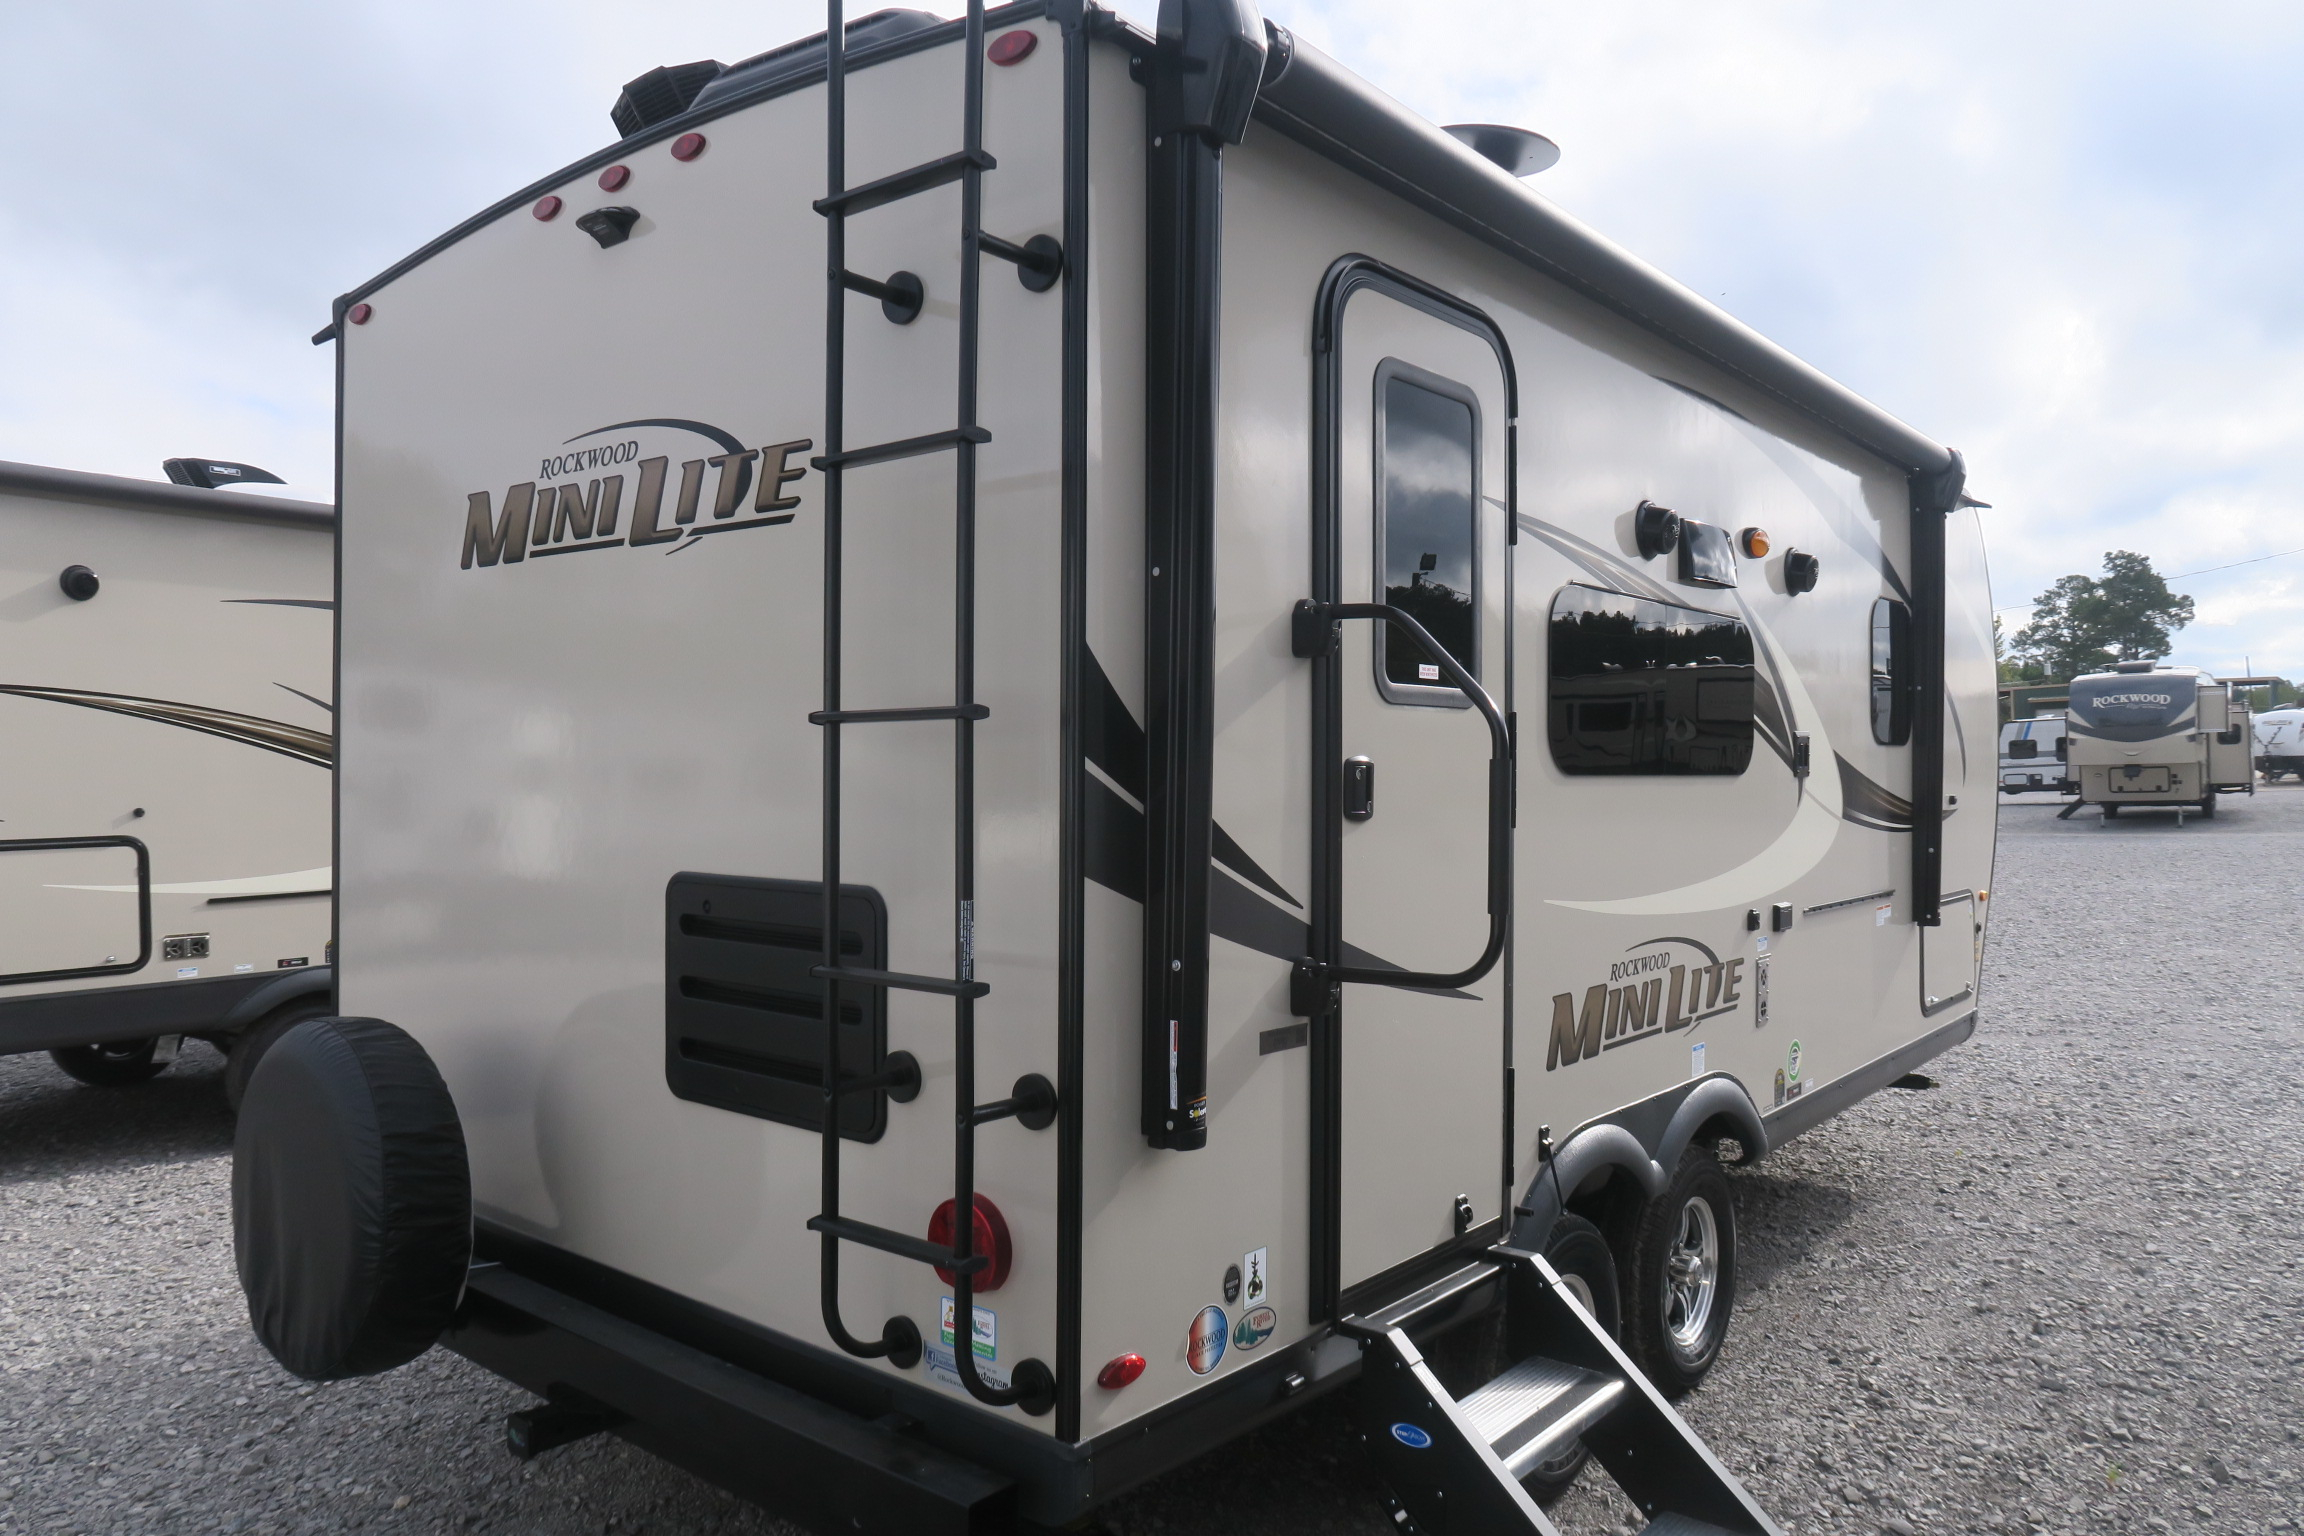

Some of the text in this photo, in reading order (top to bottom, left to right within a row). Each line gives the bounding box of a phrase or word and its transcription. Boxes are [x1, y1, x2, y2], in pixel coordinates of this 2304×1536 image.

[539, 440, 639, 480] ROCKWOOD
[2092, 693, 2171, 709] ROCKWOOD
[1609, 952, 1671, 982] ROCKWOOD
